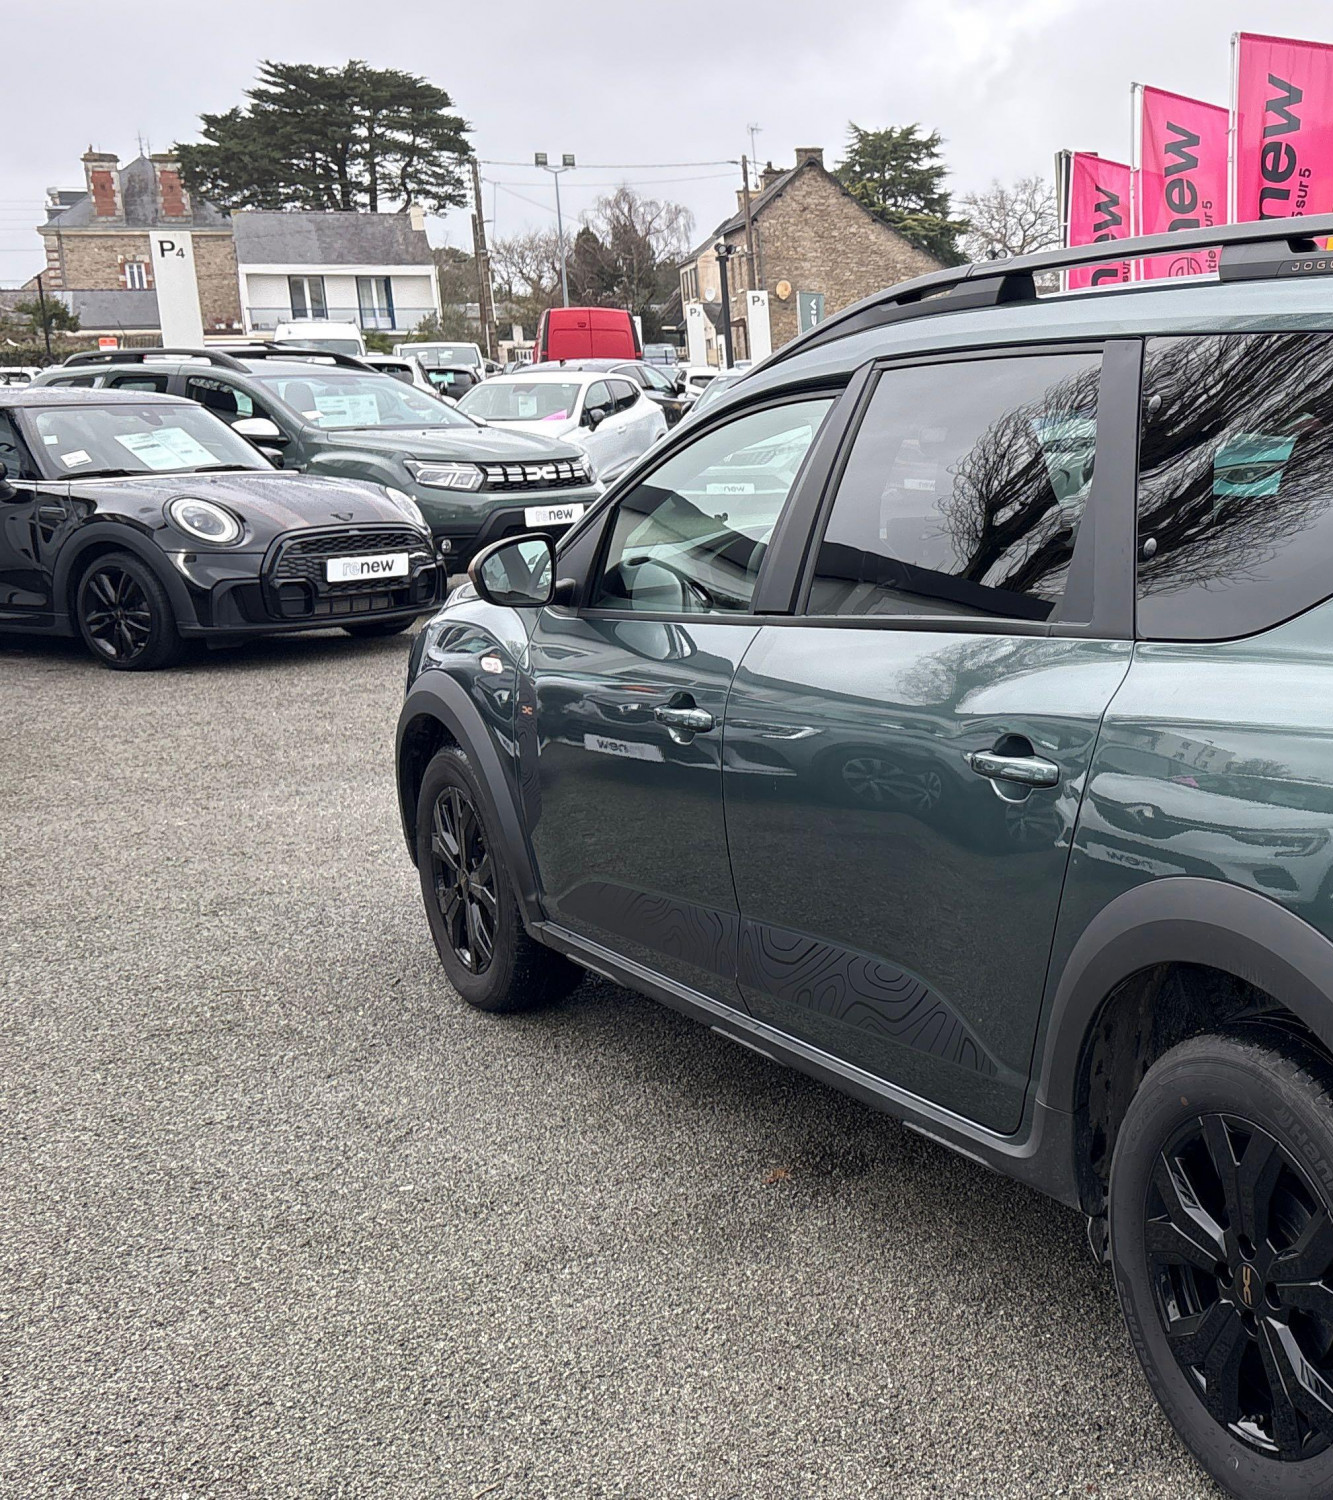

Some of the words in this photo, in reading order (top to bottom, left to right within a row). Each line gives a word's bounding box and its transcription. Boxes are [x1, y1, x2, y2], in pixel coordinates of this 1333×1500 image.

[1298, 168, 1312, 179] 5
[1295, 180, 1310, 209] sur
[1201, 200, 1213, 210] 5
[157, 239, 186, 259] P4
[535, 507, 573, 522] renew
[342, 558, 395, 576] renew
